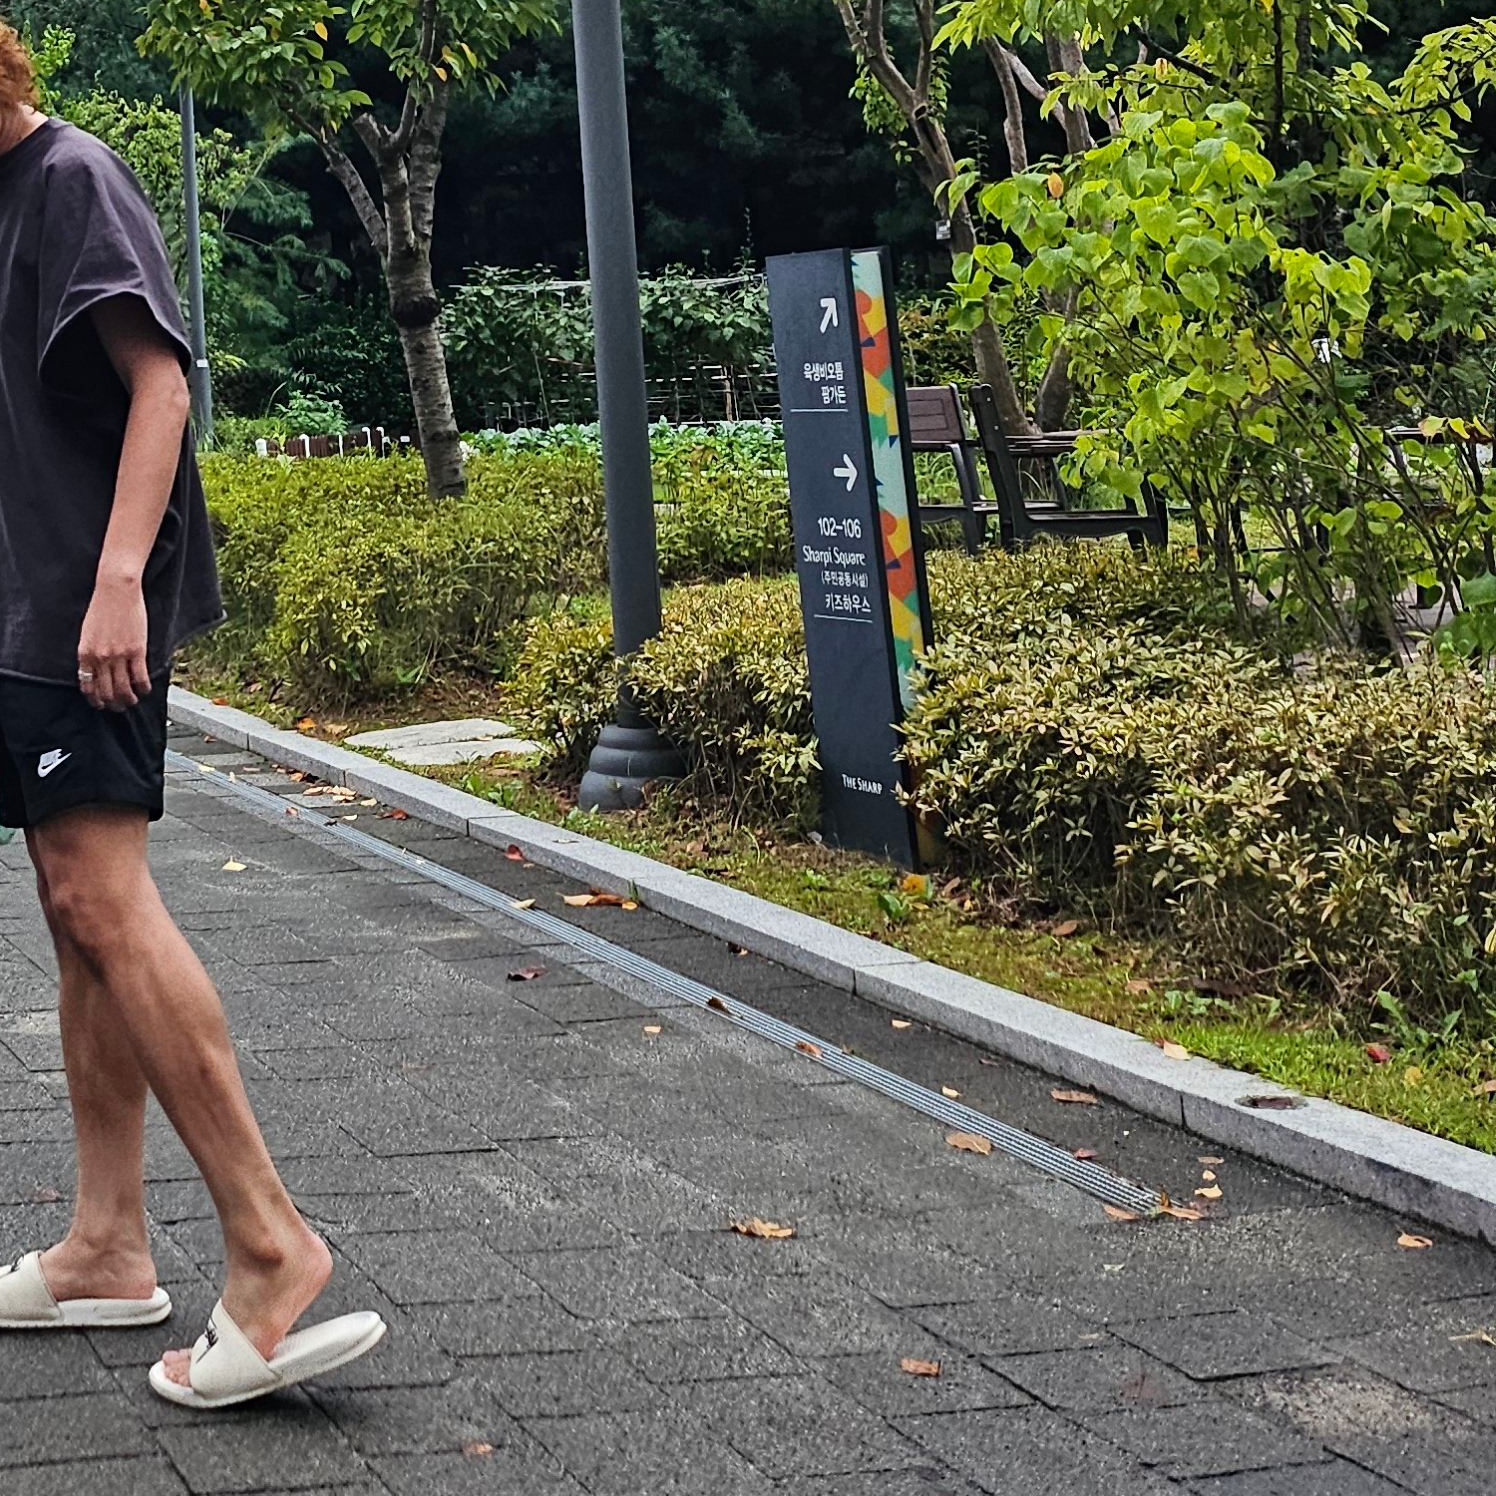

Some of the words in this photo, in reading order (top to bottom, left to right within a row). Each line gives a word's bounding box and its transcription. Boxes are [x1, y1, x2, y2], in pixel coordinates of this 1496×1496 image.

[820, 384, 847, 405] 팜가든
[817, 516, 862, 539] 102-106
[802, 545, 833, 568] Sharpi
[833, 546, 866, 569] Square
[821, 570, 869, 588] (주민공동시설)
[825, 592, 872, 614] 키즈하우스
[841, 773, 857, 790] THE
[857, 776, 883, 795] SHARP
